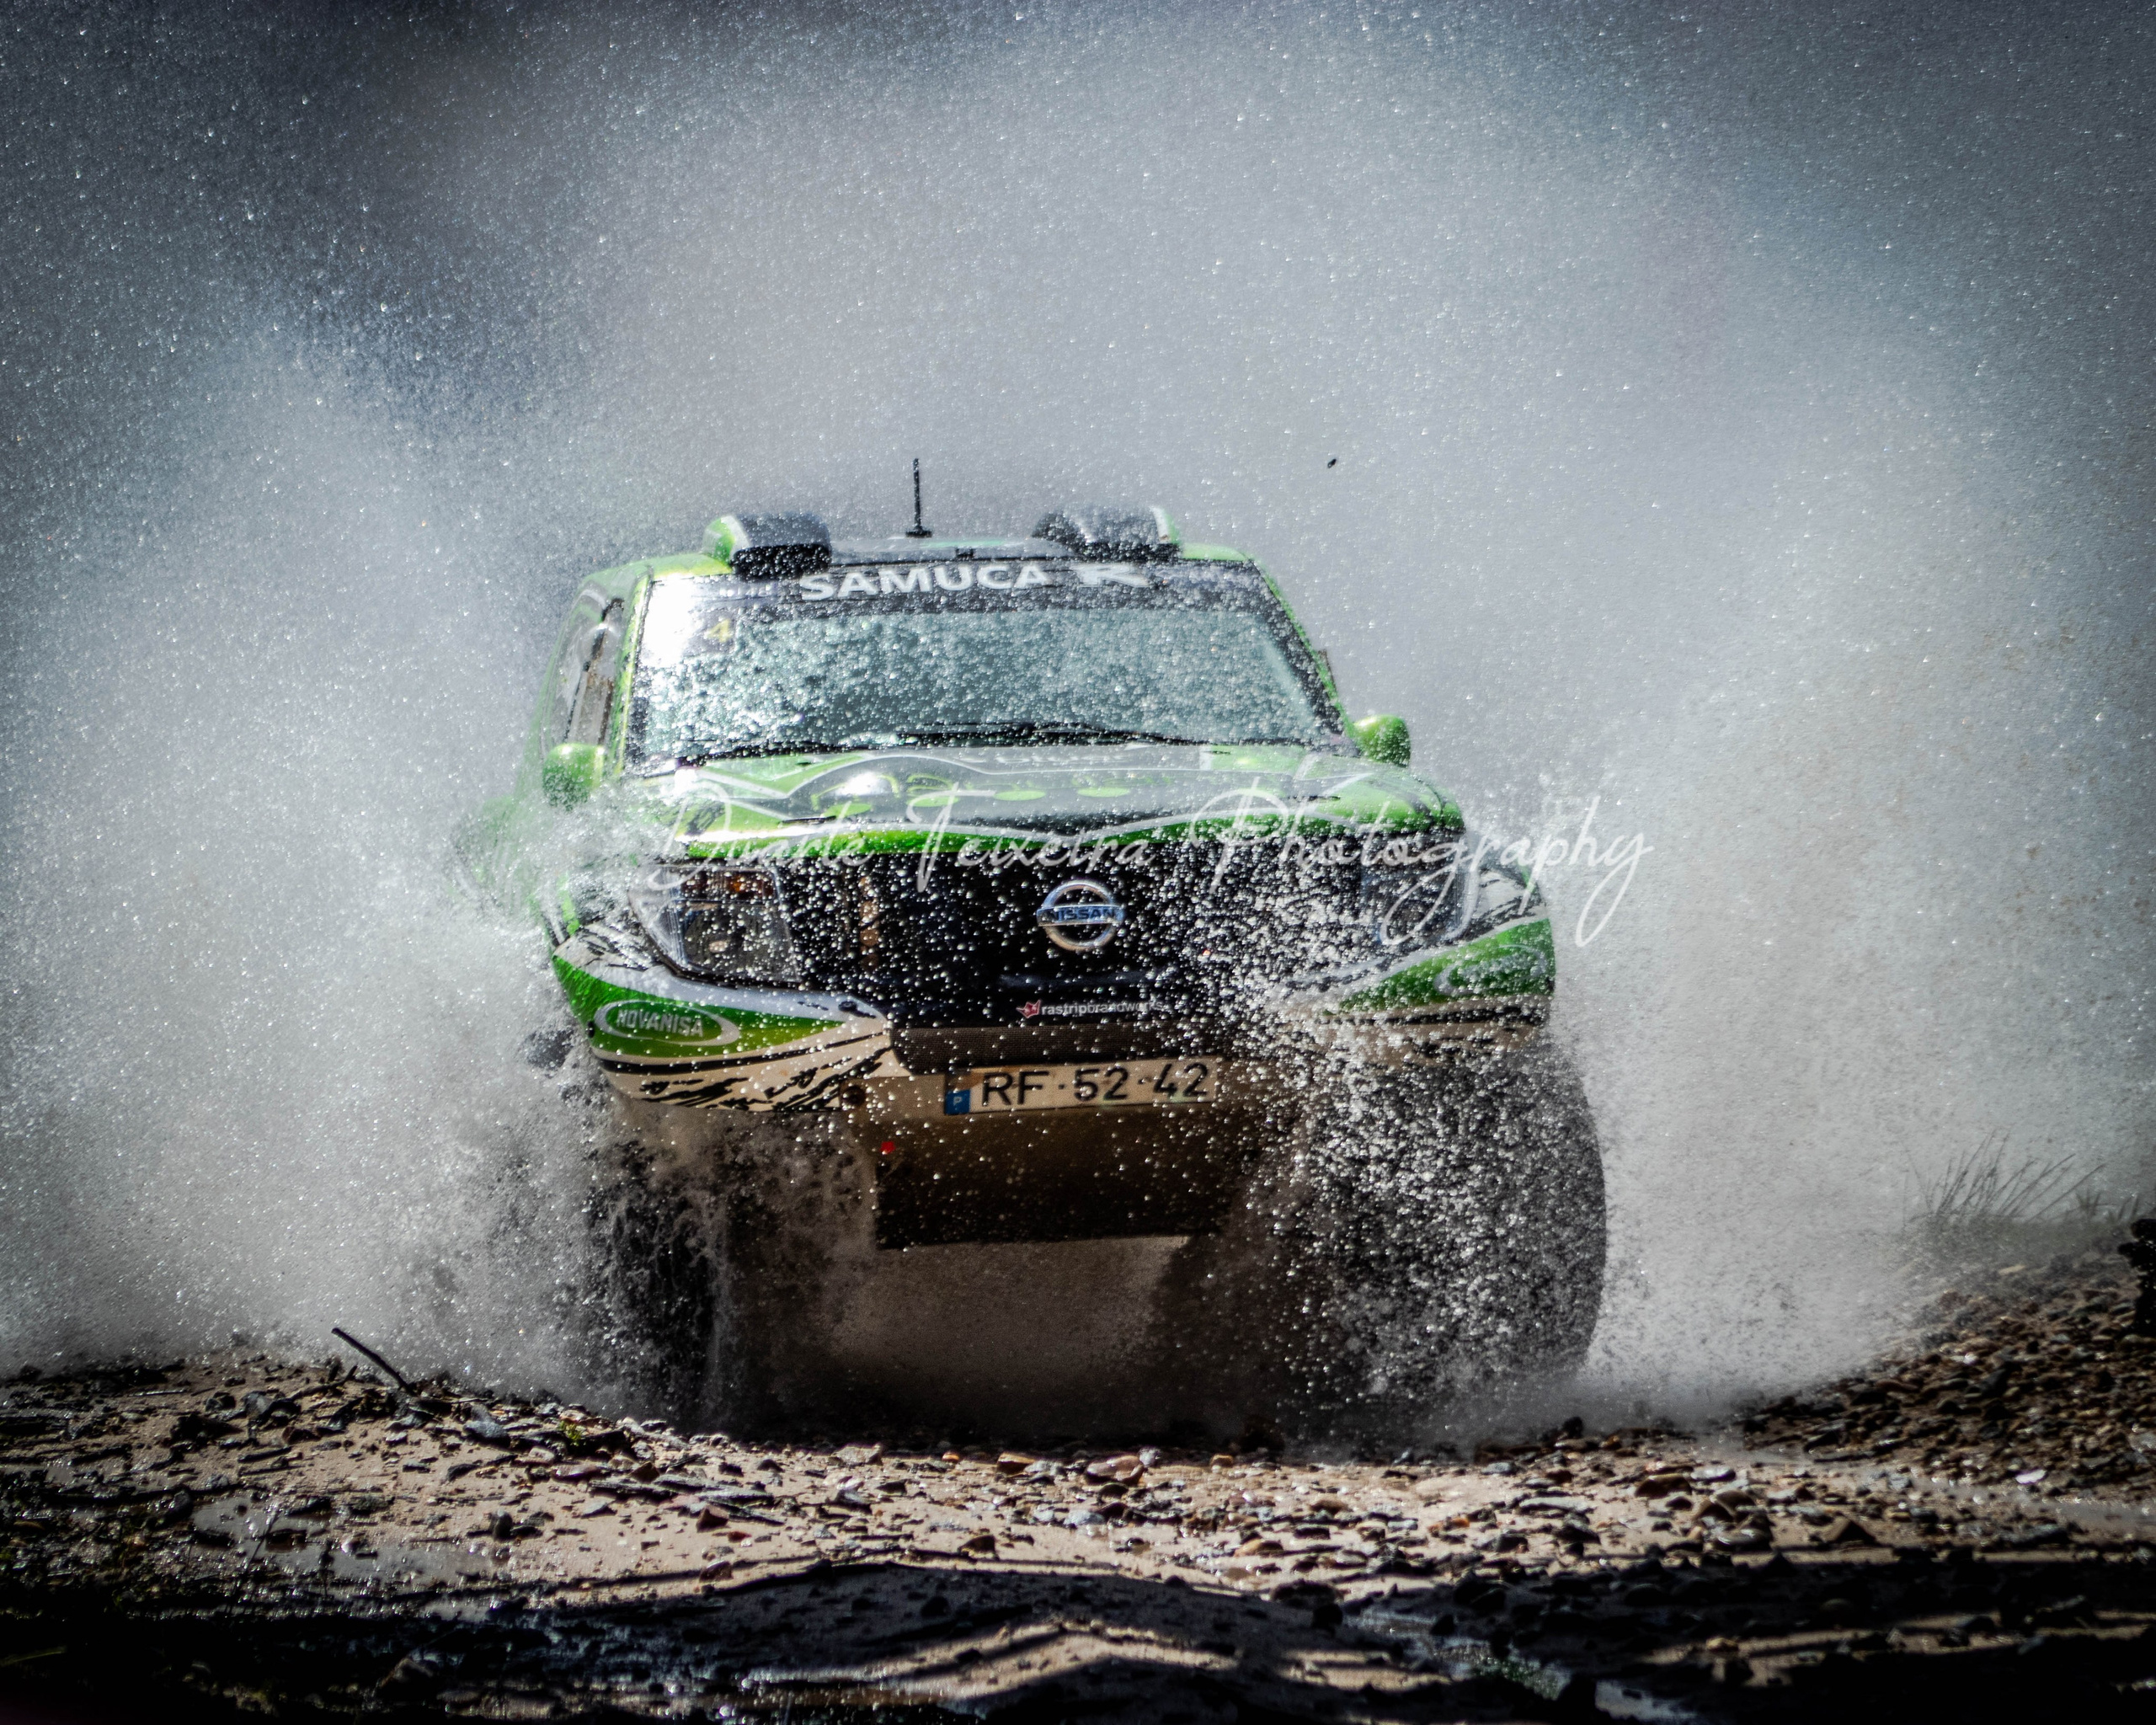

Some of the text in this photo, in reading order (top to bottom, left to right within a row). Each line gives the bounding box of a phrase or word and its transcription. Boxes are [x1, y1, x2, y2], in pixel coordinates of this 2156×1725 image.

[799, 563, 1049, 601] SAMUCA
[1047, 906, 1115, 921] NISSAN
[616, 1009, 704, 1038] NOVANISA
